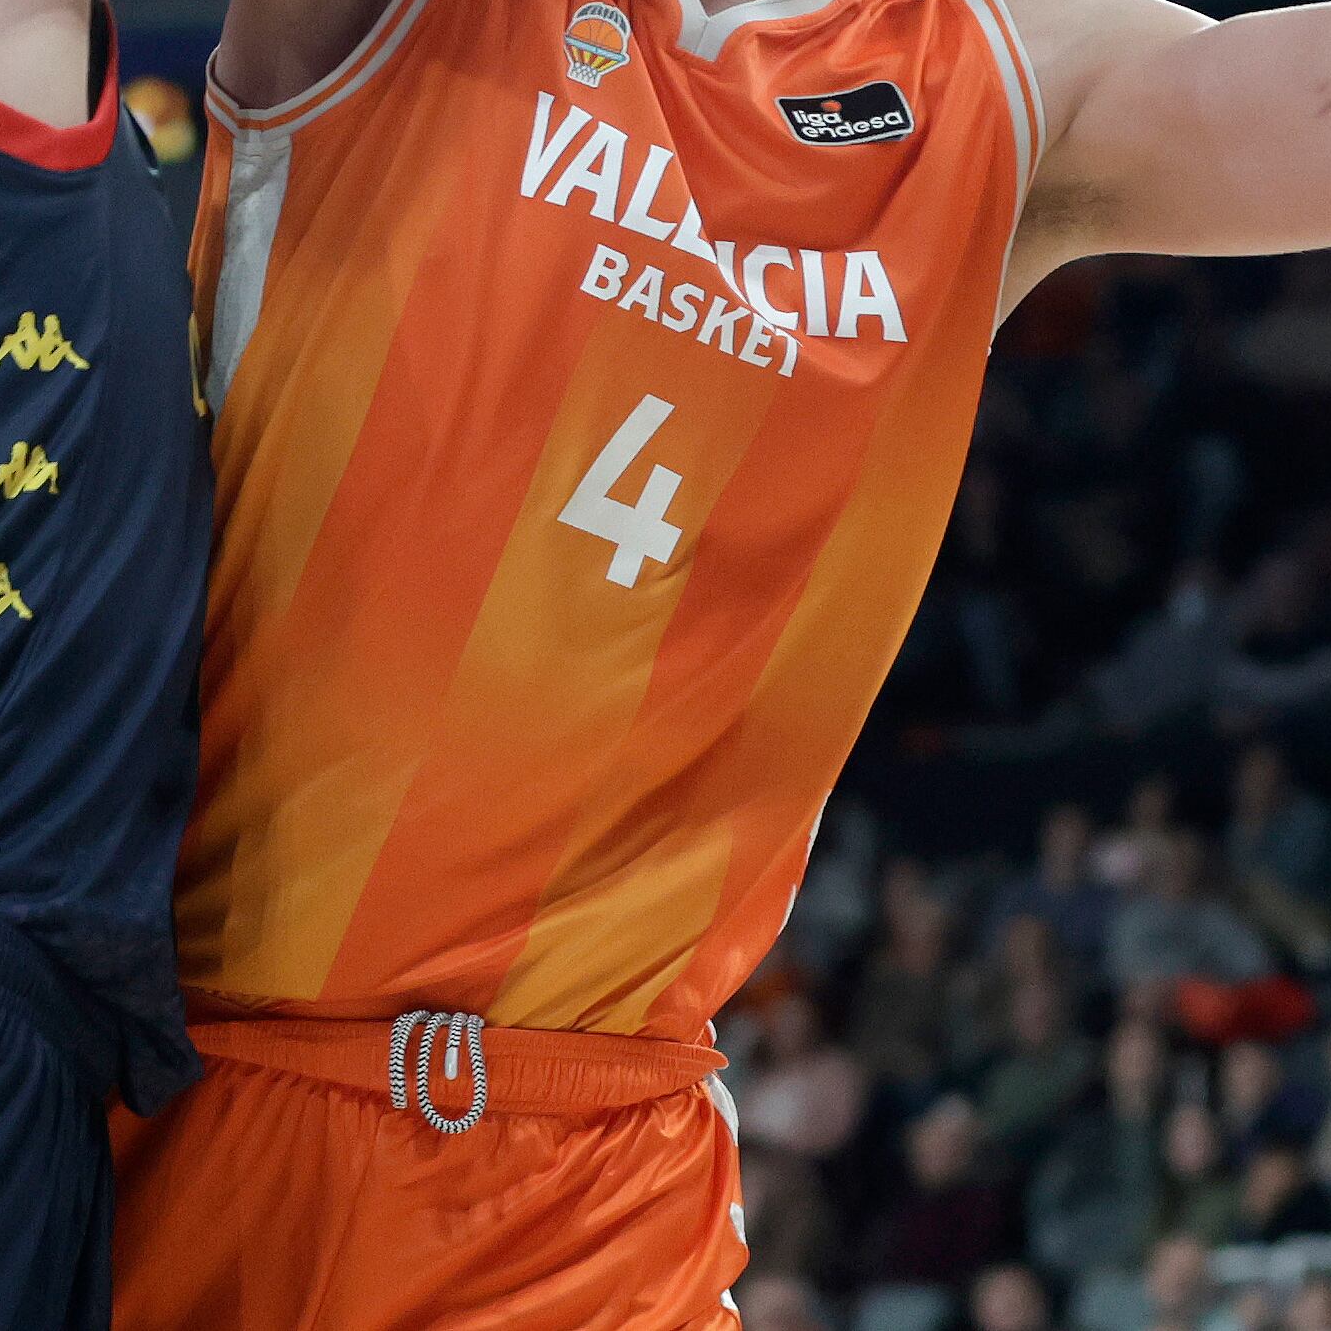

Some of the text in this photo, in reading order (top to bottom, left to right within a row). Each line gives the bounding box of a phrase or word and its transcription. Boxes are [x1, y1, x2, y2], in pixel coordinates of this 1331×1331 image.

[791, 110, 842, 128] liga
[801, 111, 904, 138] endesa
[557, 394, 683, 589] 4
